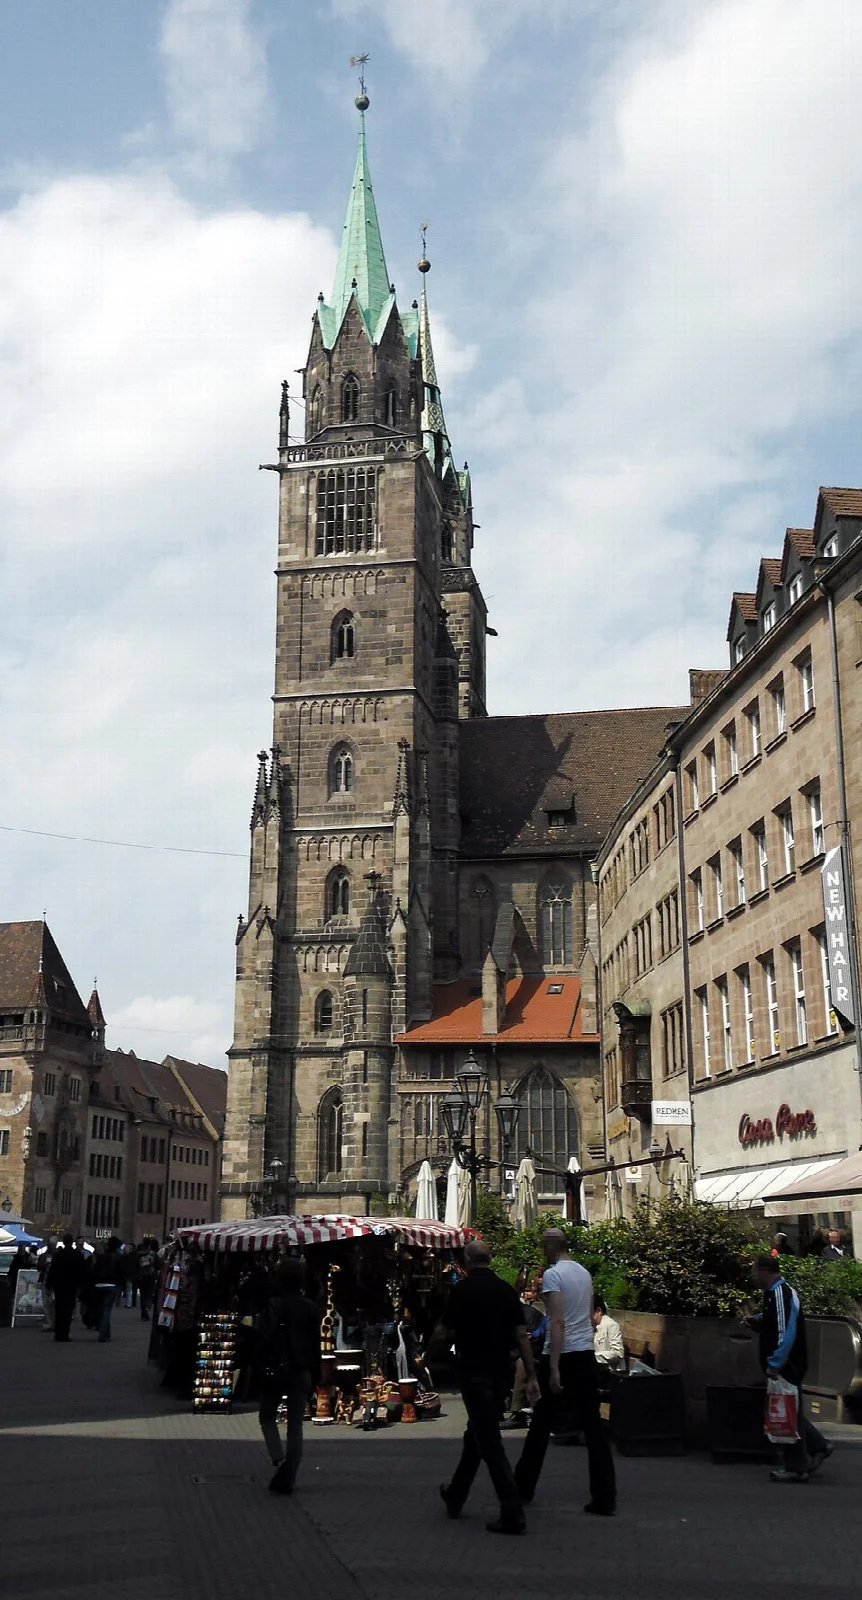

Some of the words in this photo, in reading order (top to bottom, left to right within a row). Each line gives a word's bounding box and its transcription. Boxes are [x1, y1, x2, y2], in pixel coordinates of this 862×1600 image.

[826, 870, 845, 922] NEW
[831, 932, 849, 1002] HAIR
[656, 1107, 689, 1115] REDKEN
[95, 1229, 112, 1239] LUSH
